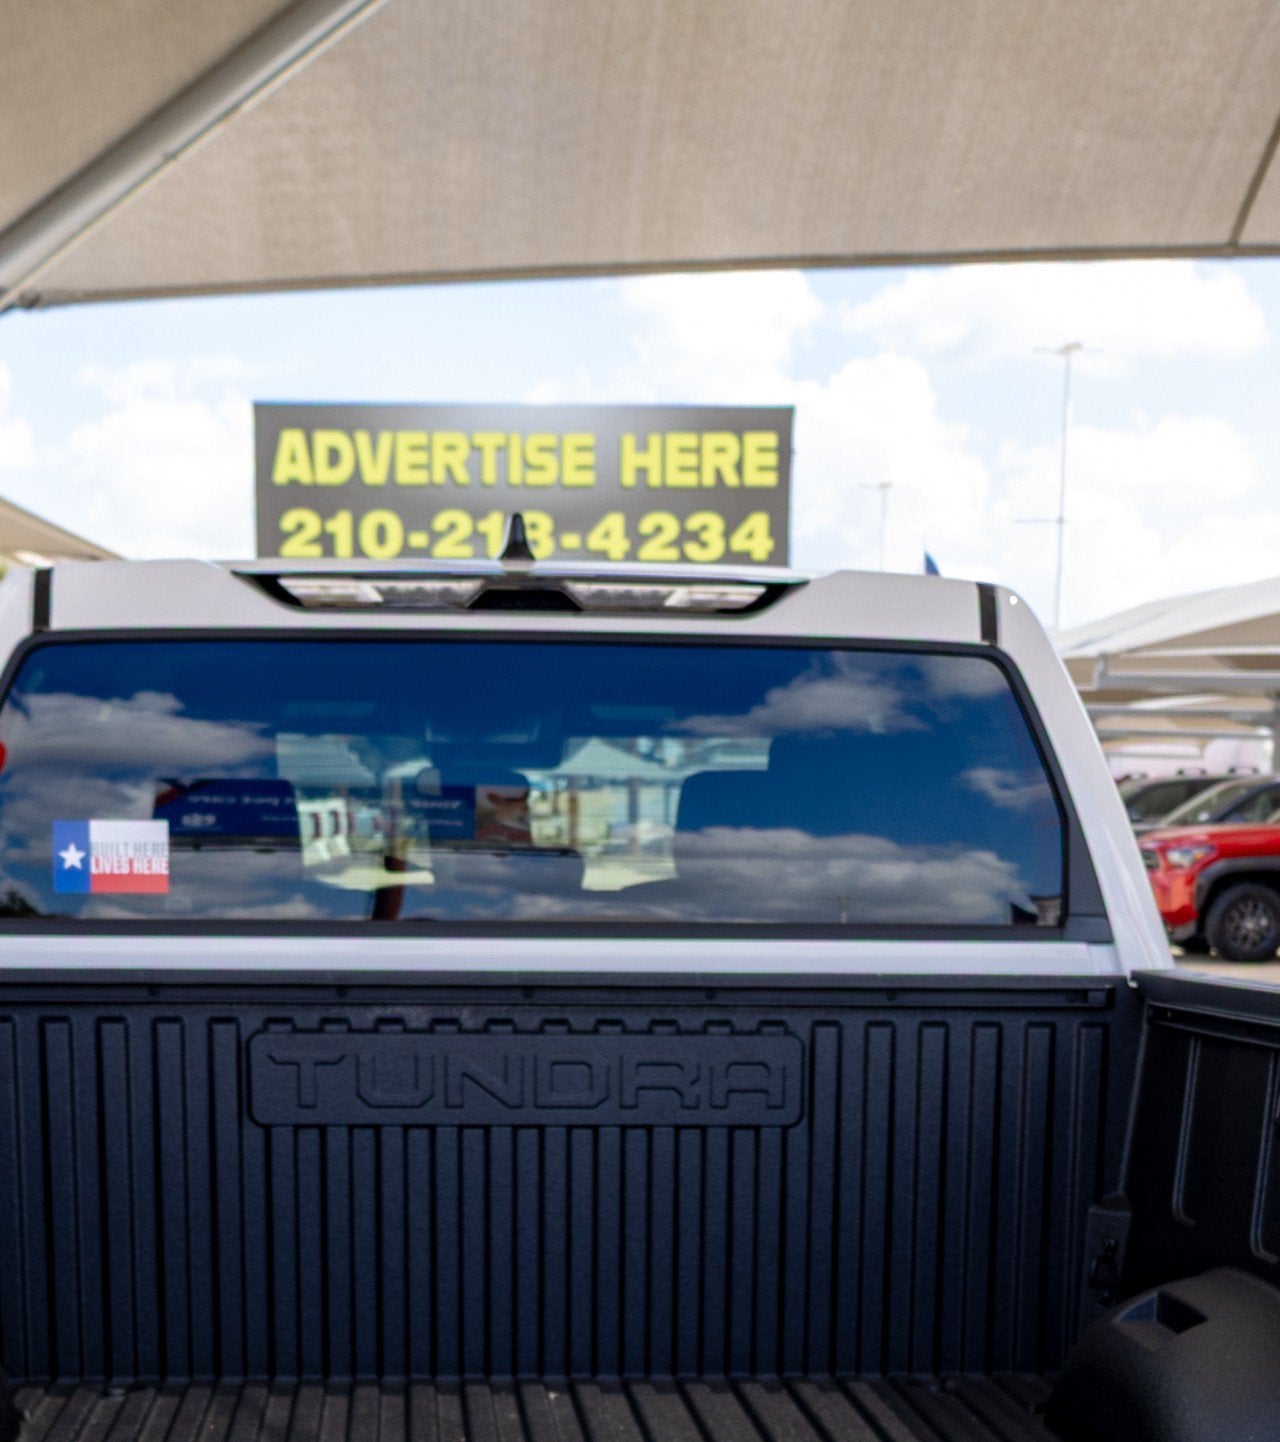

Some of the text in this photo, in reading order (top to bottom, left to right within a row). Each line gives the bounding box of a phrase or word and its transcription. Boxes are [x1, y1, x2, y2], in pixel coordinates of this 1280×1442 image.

[272, 427, 780, 488] ADVERTISE HERE
[90, 856, 169, 875] LIVES HERE
[91, 841, 169, 857] BUILT HERE
[267, 1052, 787, 1109] TUNDRA
